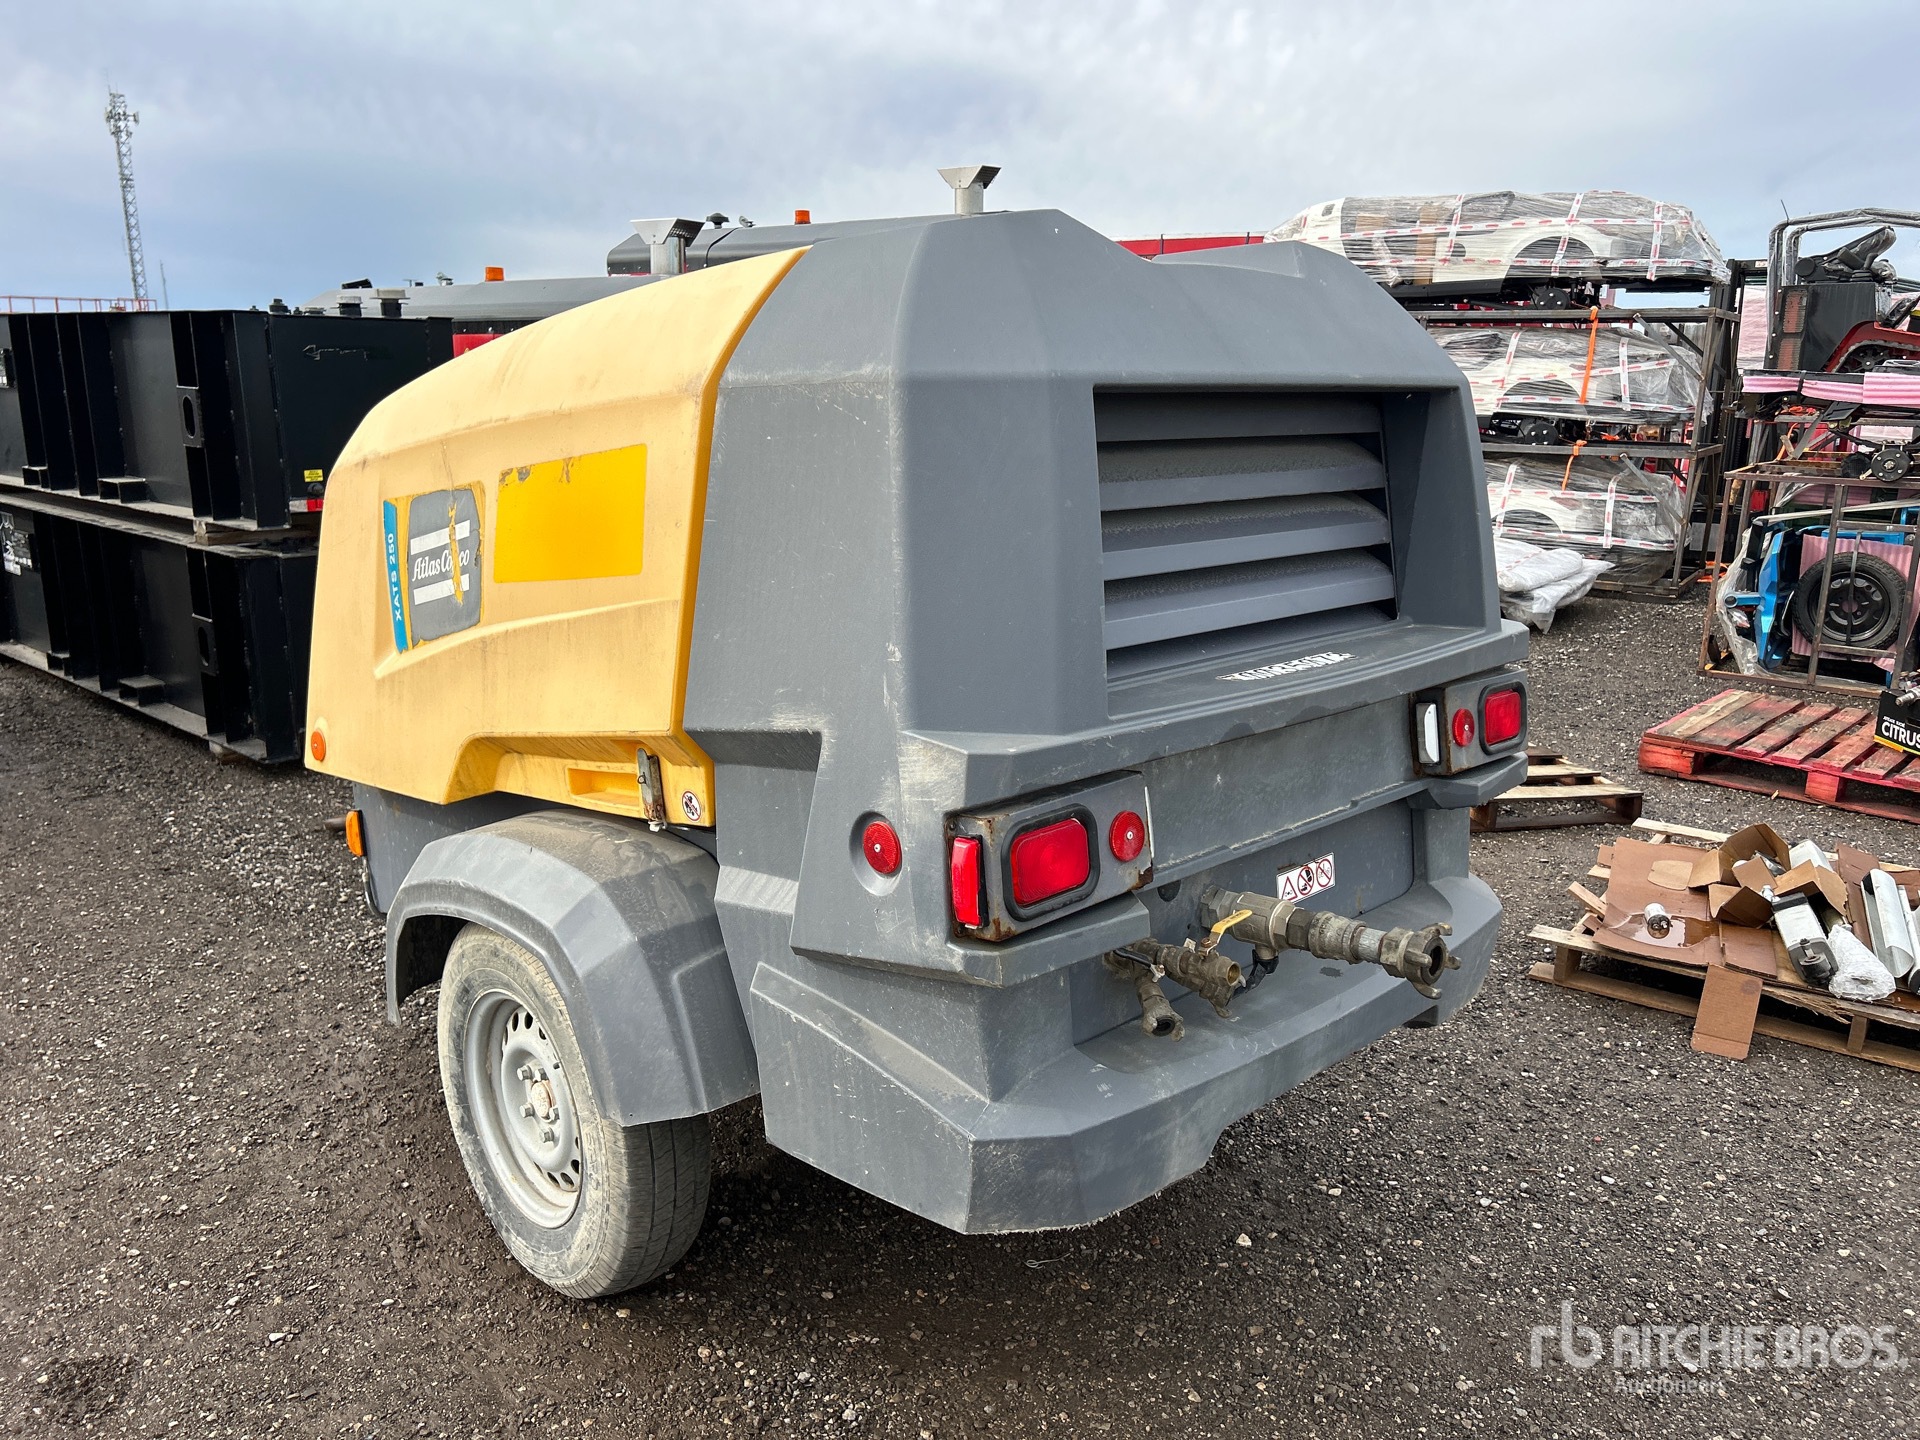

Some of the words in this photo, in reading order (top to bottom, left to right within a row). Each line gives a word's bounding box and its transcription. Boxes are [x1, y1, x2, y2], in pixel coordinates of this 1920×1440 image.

[387, 533, 396, 565] 250
[411, 555, 441, 582] Atlas
[440, 549, 470, 573] Coco
[391, 571, 402, 621] XATS
